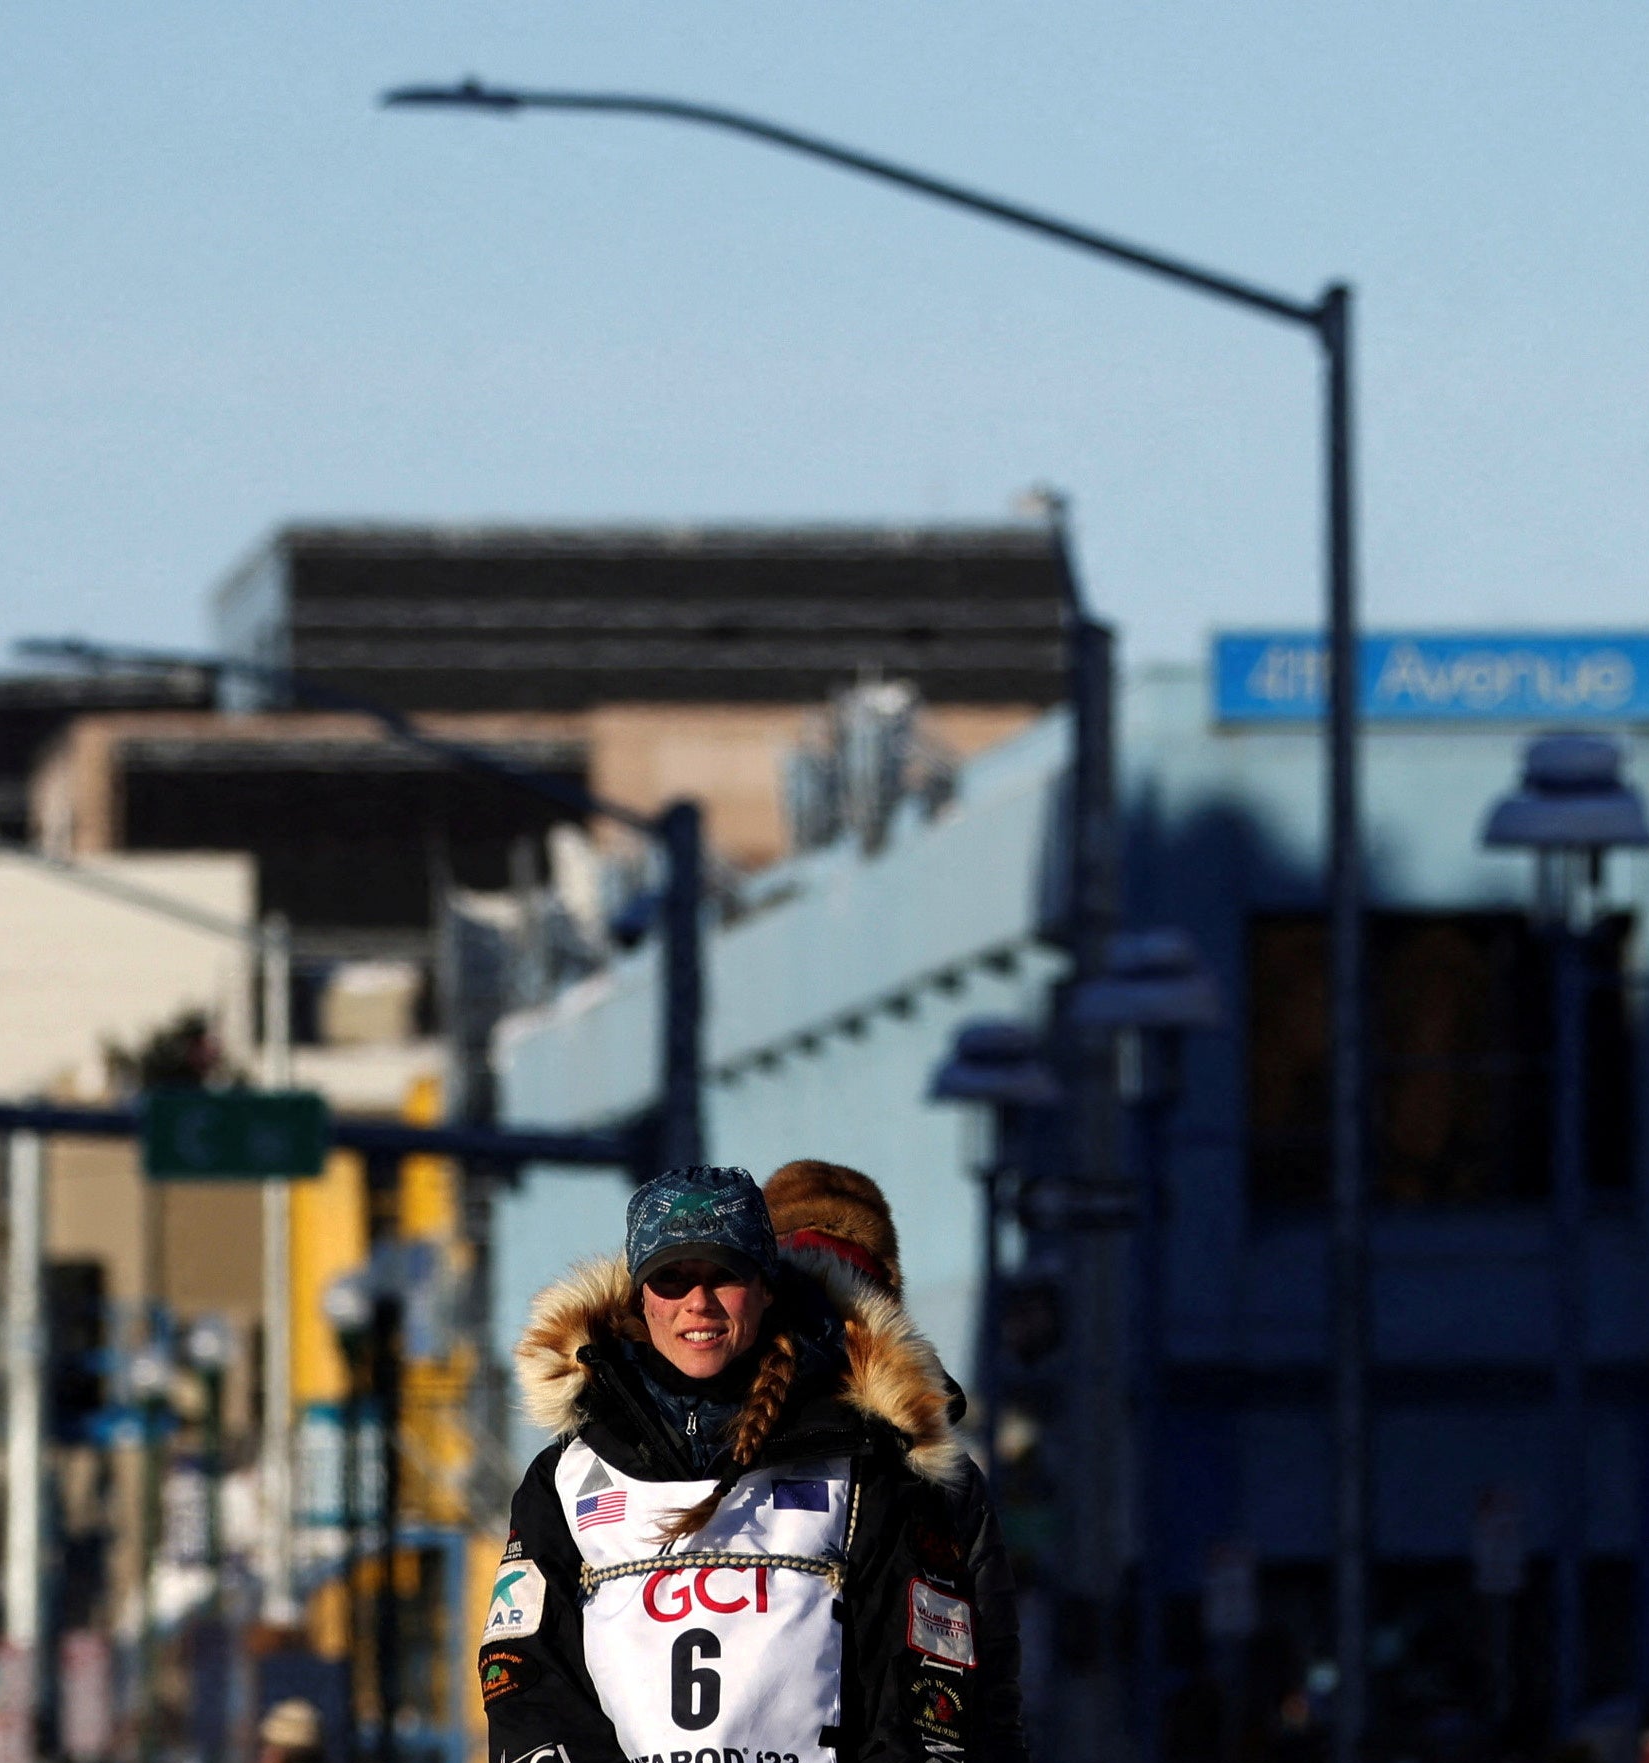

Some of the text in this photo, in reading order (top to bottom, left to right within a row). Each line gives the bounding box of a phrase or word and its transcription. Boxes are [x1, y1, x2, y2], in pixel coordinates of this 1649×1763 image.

[1372, 640, 1636, 710] Avenue
[642, 1566, 768, 1623] GCI
[671, 1627, 722, 1731] 6
